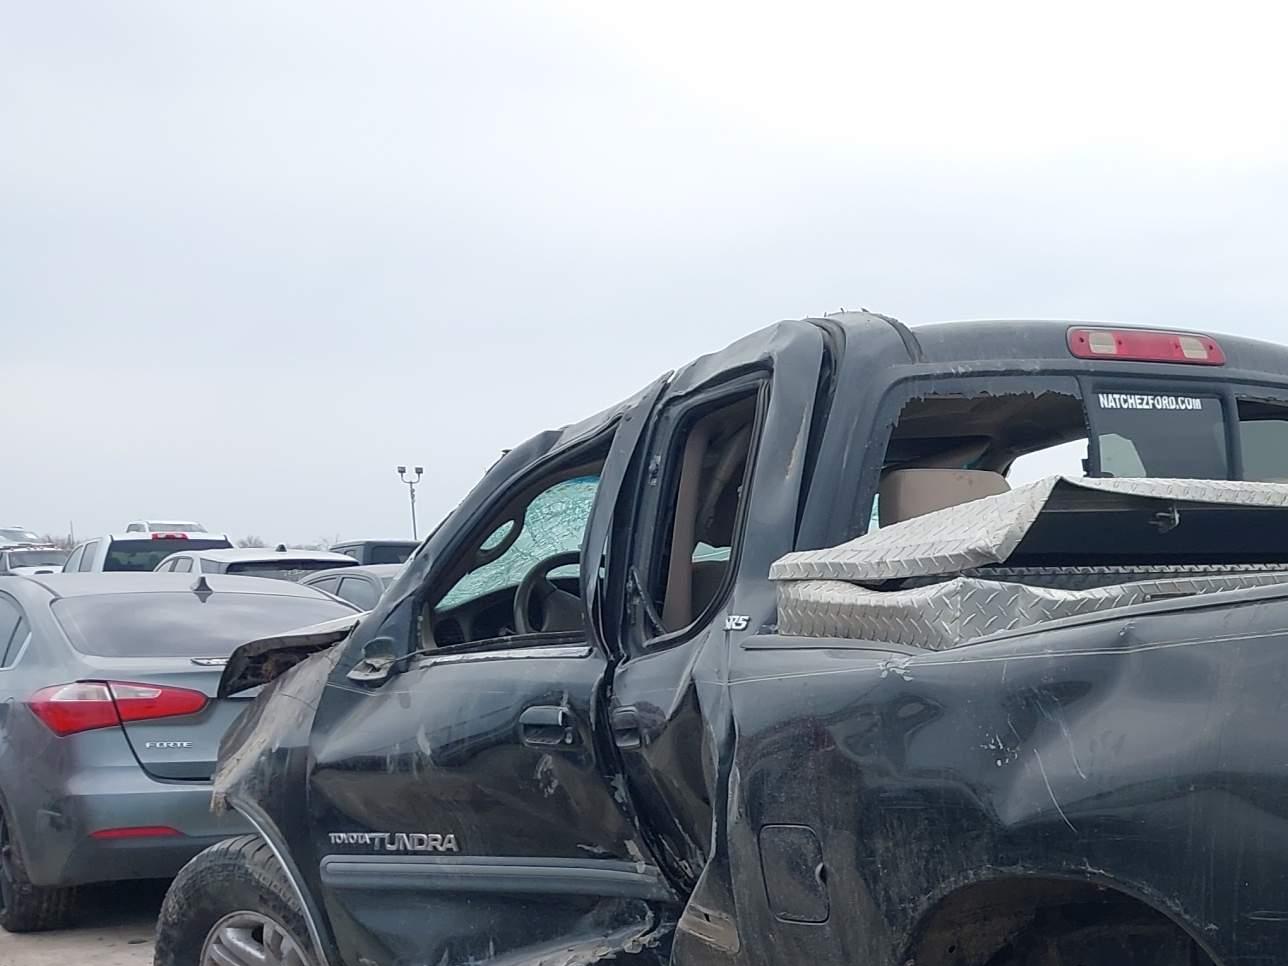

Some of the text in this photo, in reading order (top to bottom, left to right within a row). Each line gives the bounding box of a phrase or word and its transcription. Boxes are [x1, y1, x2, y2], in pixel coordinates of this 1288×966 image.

[1098, 393, 1202, 410] NATCHEZFORD.COM
[328, 832, 460, 852] TOYOTA TUNDRA
